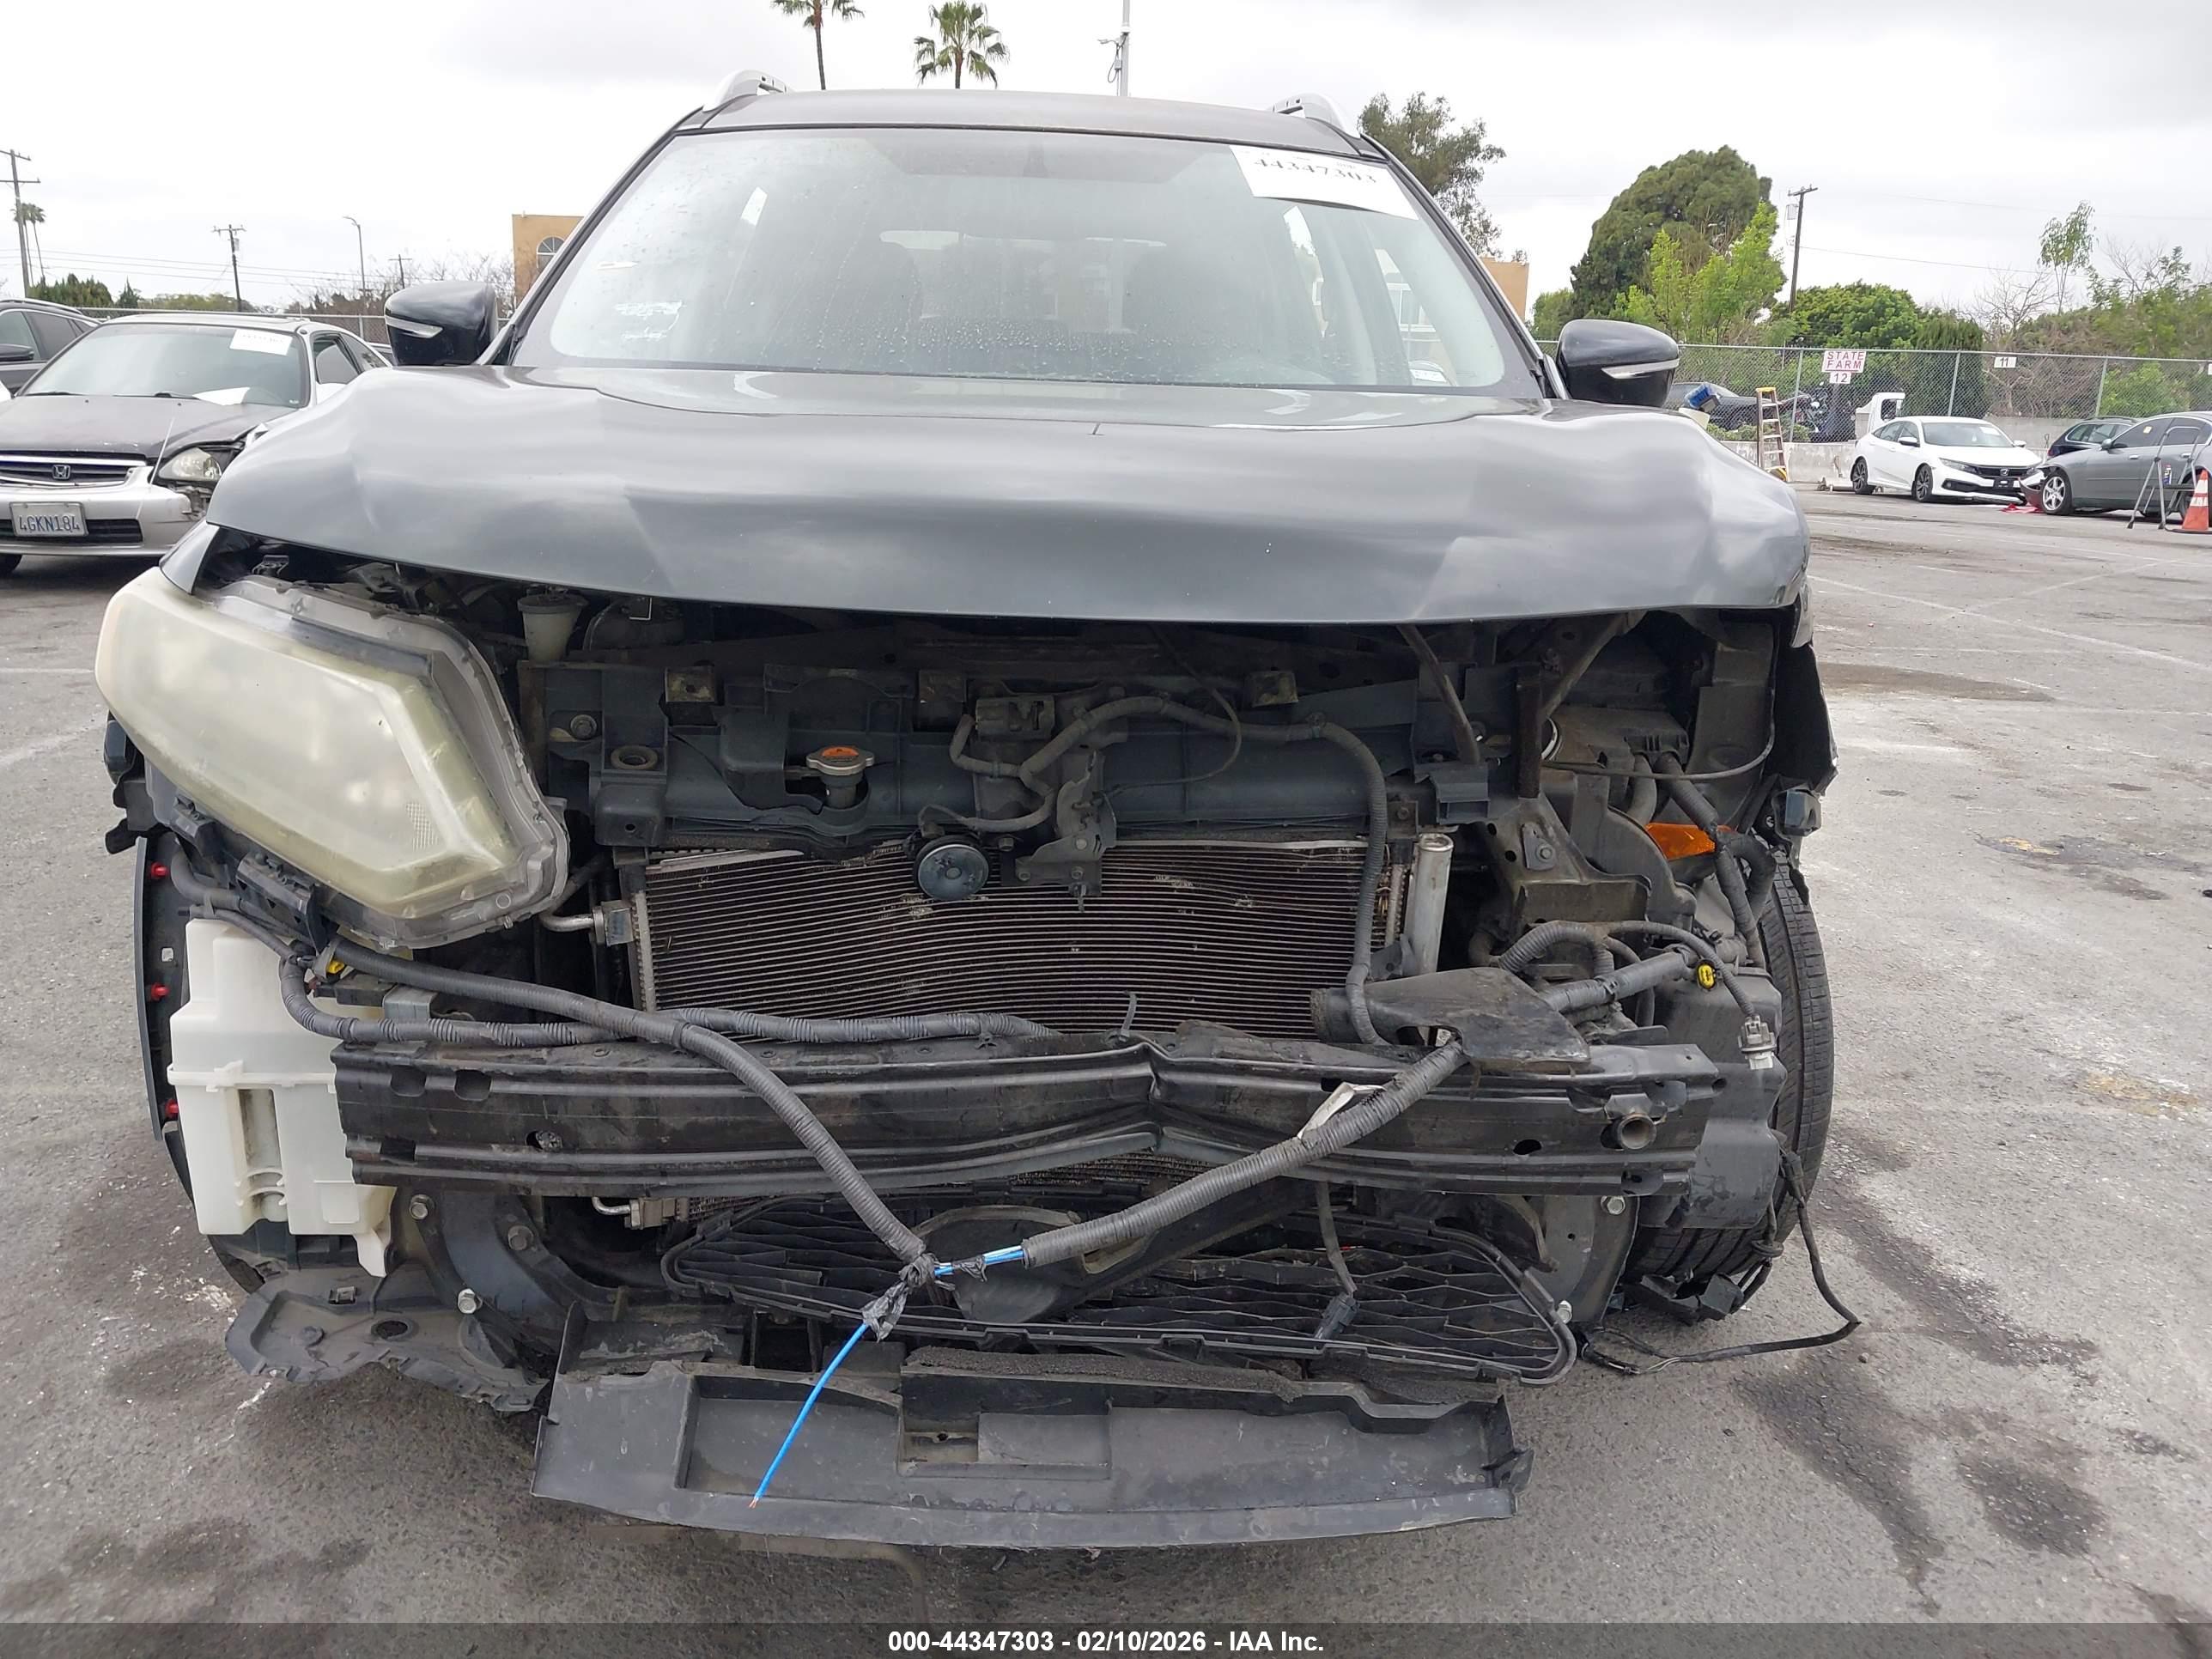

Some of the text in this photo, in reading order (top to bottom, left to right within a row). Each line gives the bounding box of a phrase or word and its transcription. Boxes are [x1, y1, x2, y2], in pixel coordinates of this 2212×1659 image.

[1826, 351, 1865, 361] STATE
[1826, 360, 1862, 369] FARM
[2000, 357, 2009, 368] 11
[1833, 373, 1848, 383] 12
[19, 515, 81, 532] 4GKN184
